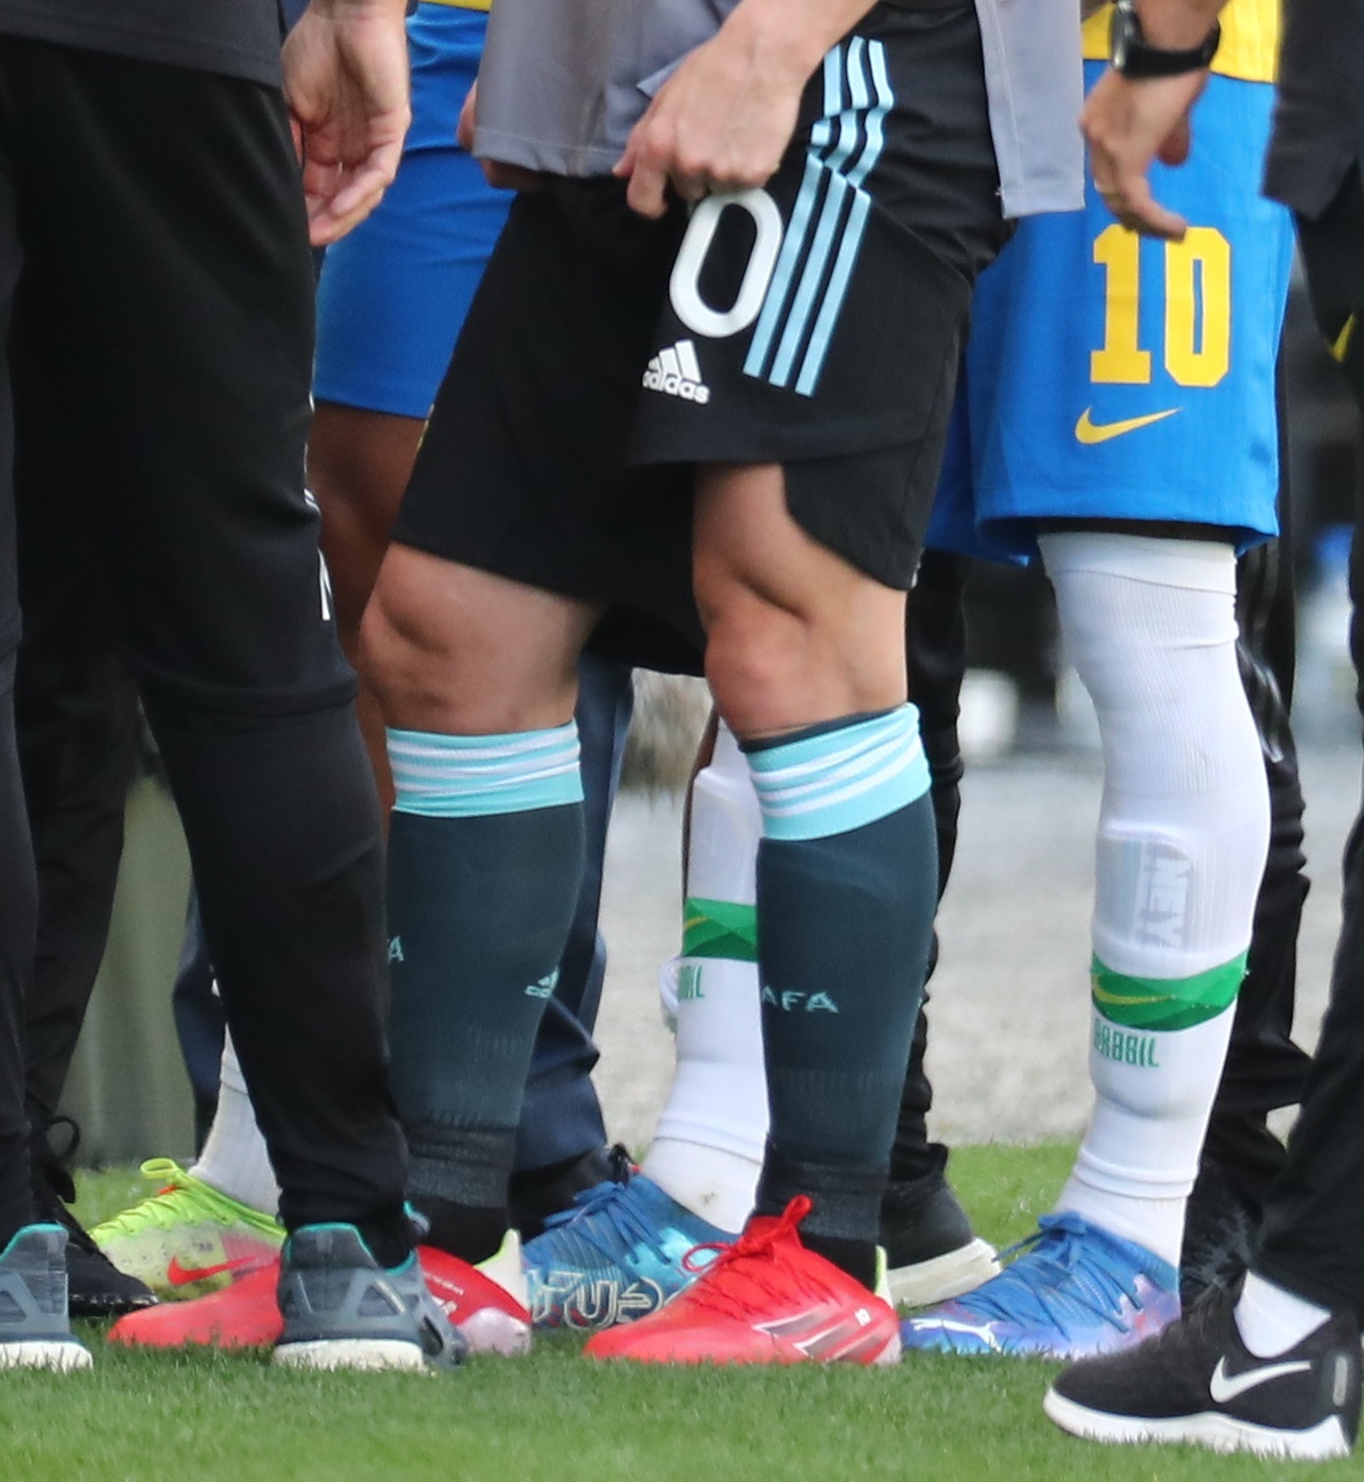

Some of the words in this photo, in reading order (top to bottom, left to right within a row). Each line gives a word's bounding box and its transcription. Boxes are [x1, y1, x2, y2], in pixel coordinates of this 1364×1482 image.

[1090, 223, 1232, 388] 10
[642, 365, 711, 405] adidas
[761, 985, 839, 1013] AFA
